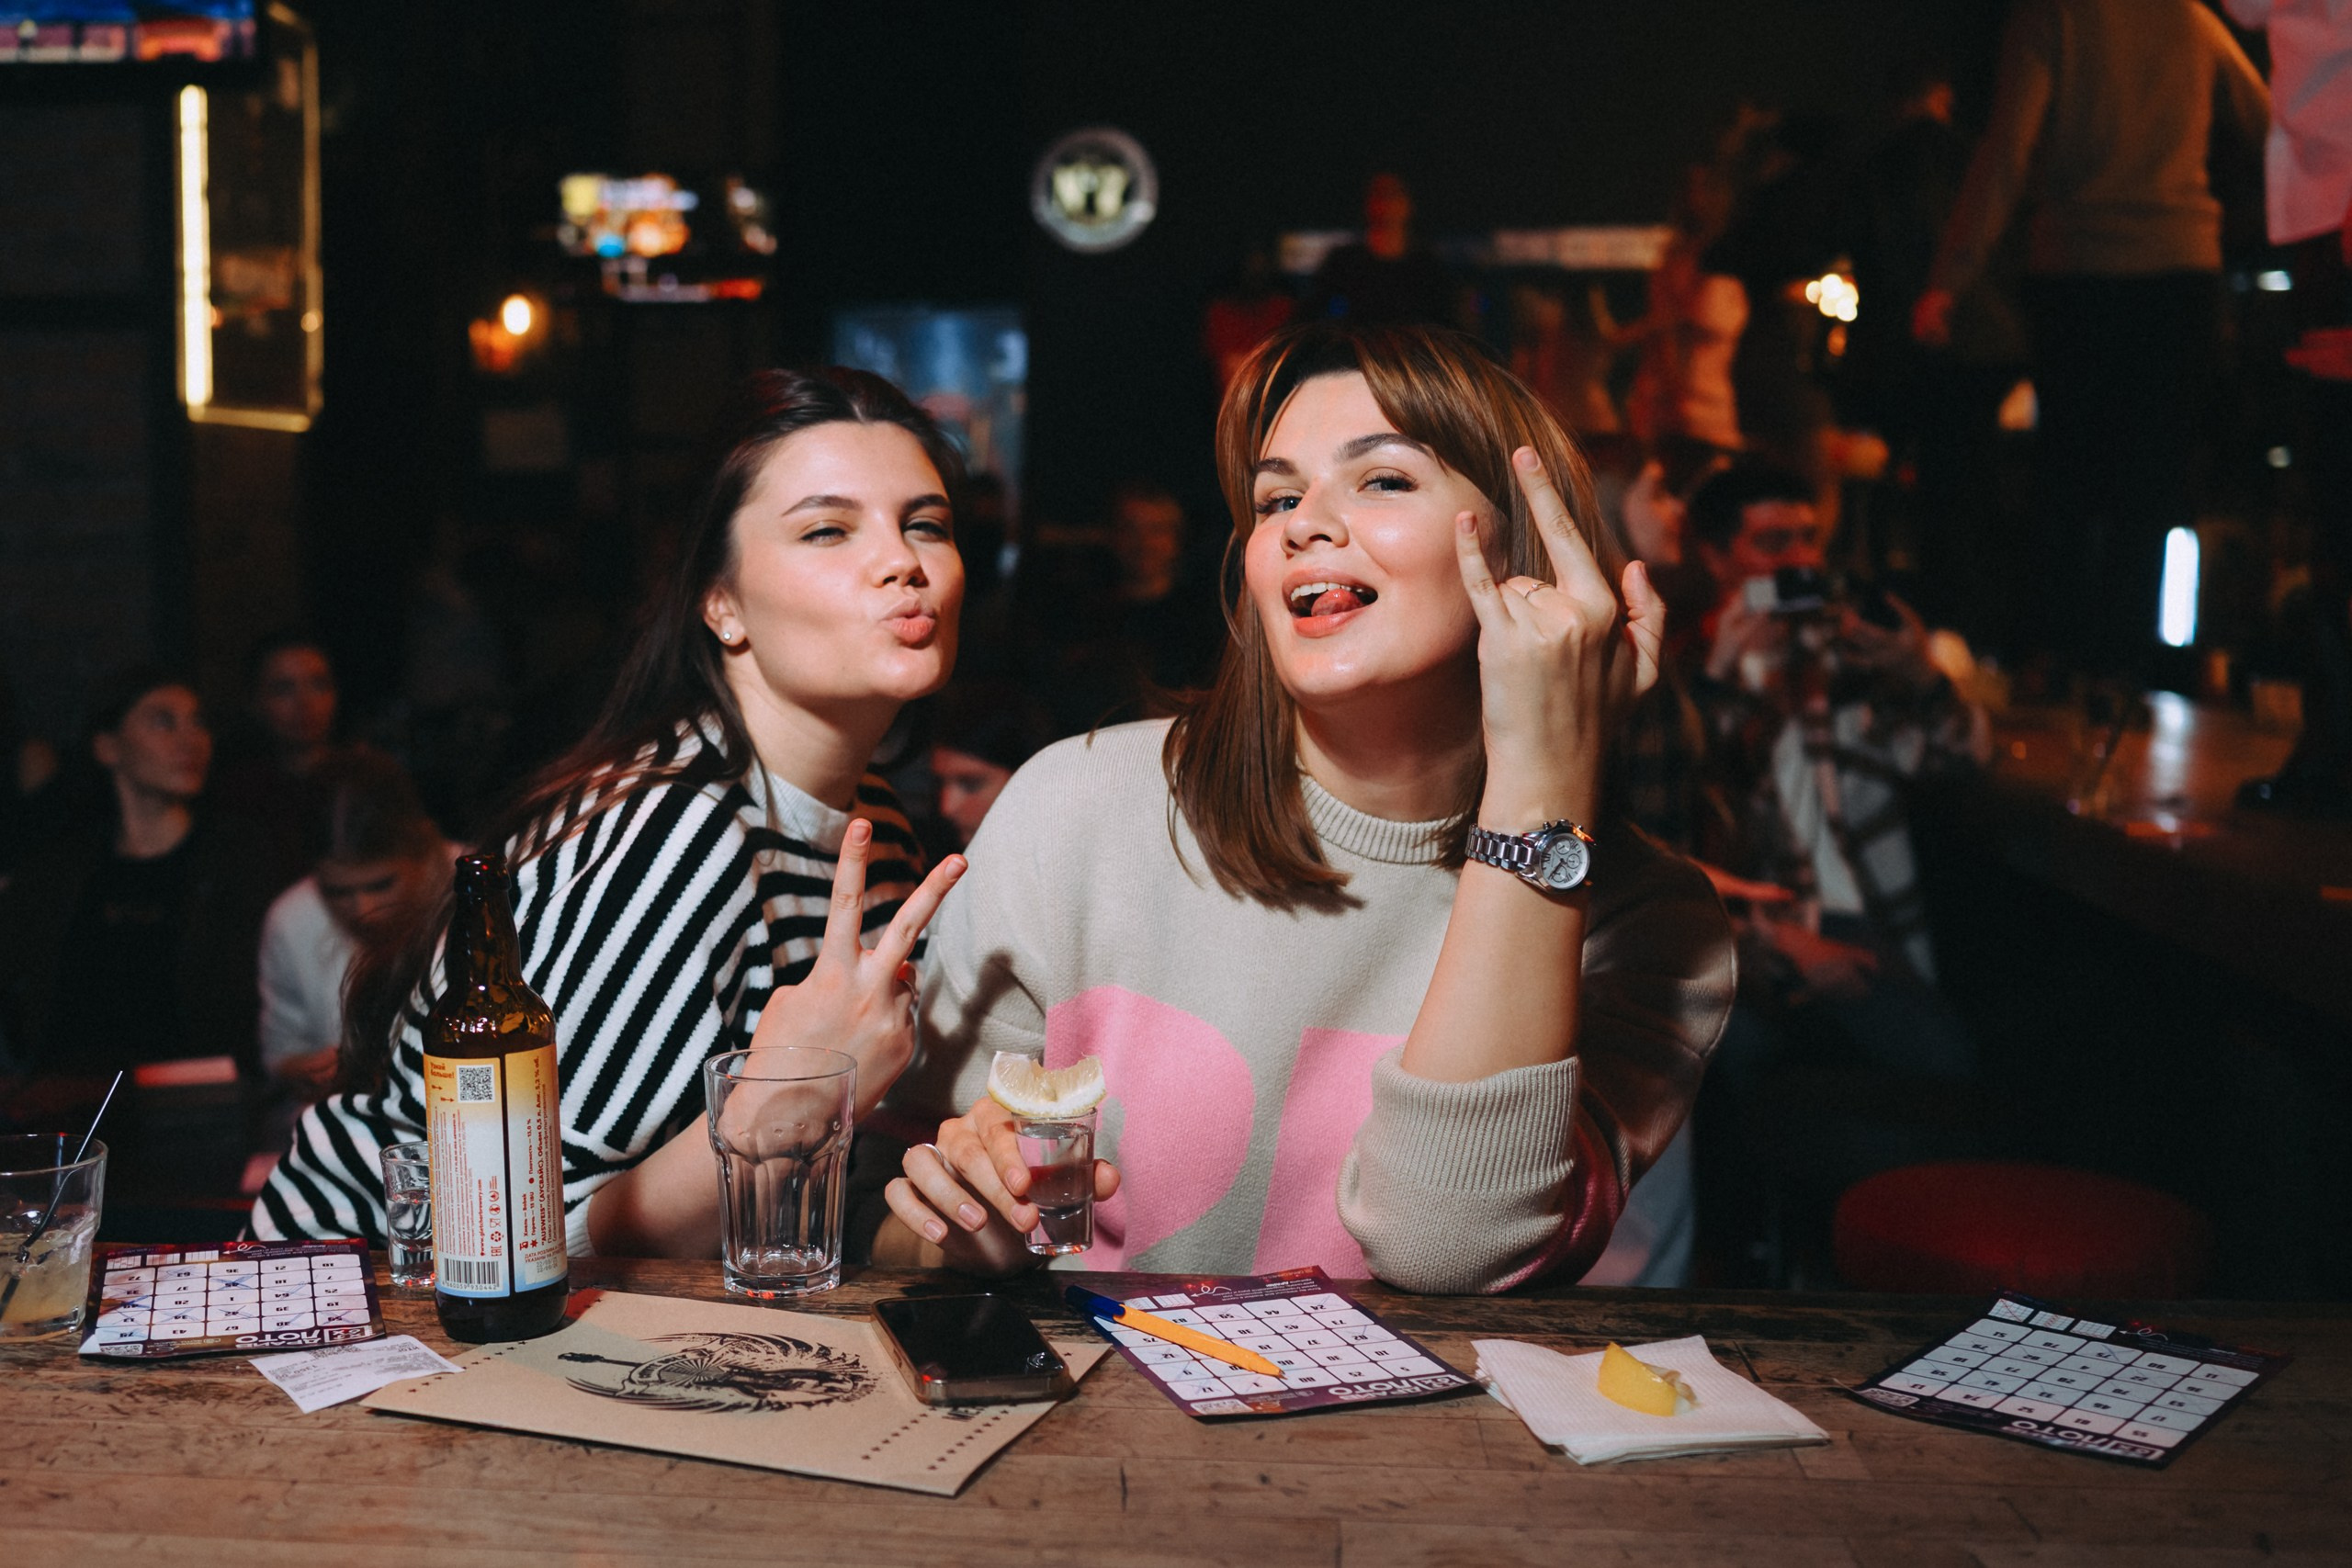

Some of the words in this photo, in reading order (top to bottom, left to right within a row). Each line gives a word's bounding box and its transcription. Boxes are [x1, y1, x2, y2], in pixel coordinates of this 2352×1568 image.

[235, 1329, 321, 1344] ЛОТО
[1329, 1379, 1413, 1395] ЛОТО
[2010, 1420, 2109, 1451] ЛОТО
